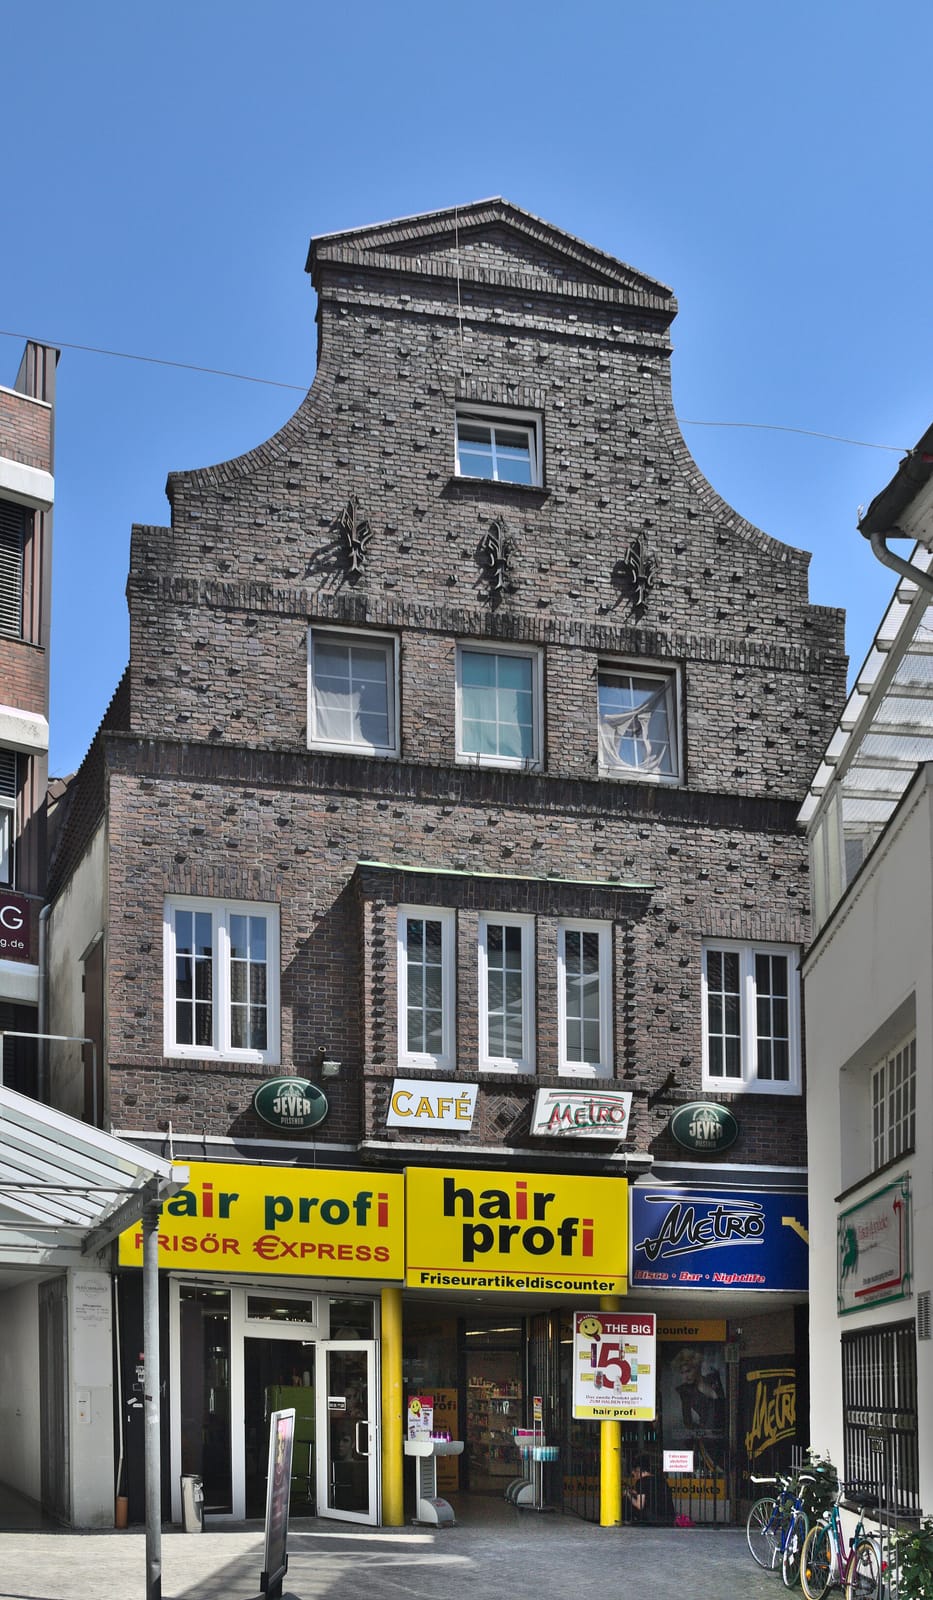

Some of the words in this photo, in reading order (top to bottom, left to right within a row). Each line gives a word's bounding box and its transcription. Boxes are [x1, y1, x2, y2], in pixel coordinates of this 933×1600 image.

[273, 1096, 311, 1117] JEVER
[391, 1090, 472, 1121] CAFÉ
[689, 1121, 723, 1140] JEVER
[158, 1183, 239, 1218] air
[264, 1191, 389, 1231] profi
[443, 1177, 556, 1220] hair
[462, 1218, 594, 1262] profi
[420, 1272, 615, 1291] Friseurartikeldiscounter
[635, 1271, 669, 1280] Disco
[679, 1271, 703, 1281] Bar
[712, 1272, 766, 1285] Nightlife
[605, 1323, 628, 1333] THE
[631, 1324, 651, 1334] BIG
[613, 1408, 637, 1417] profi
